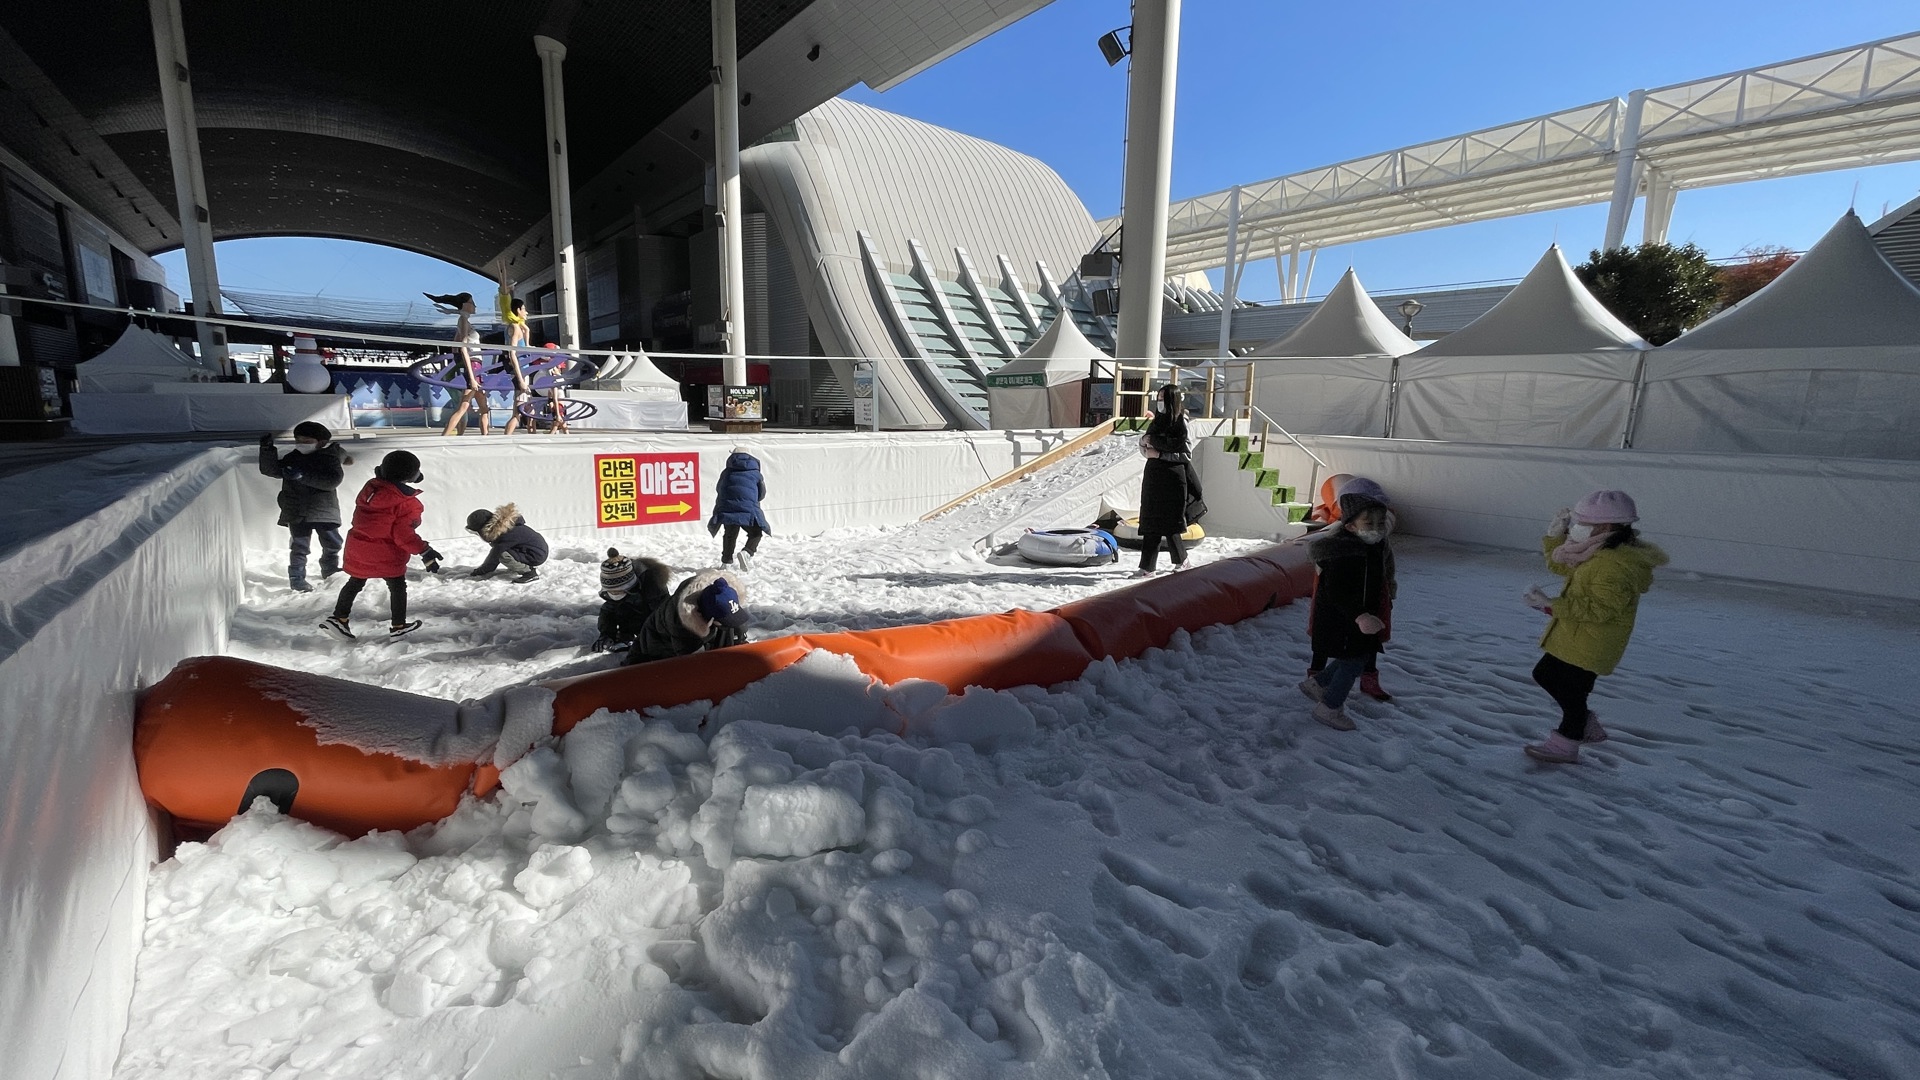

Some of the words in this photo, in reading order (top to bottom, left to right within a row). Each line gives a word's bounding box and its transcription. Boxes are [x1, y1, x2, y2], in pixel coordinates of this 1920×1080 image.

[602, 460, 634, 477] 라면
[640, 461, 694, 495] 매점
[603, 481, 634, 499] 어묵
[604, 502, 635, 520] 핫팩
[728, 599, 740, 614] LA
